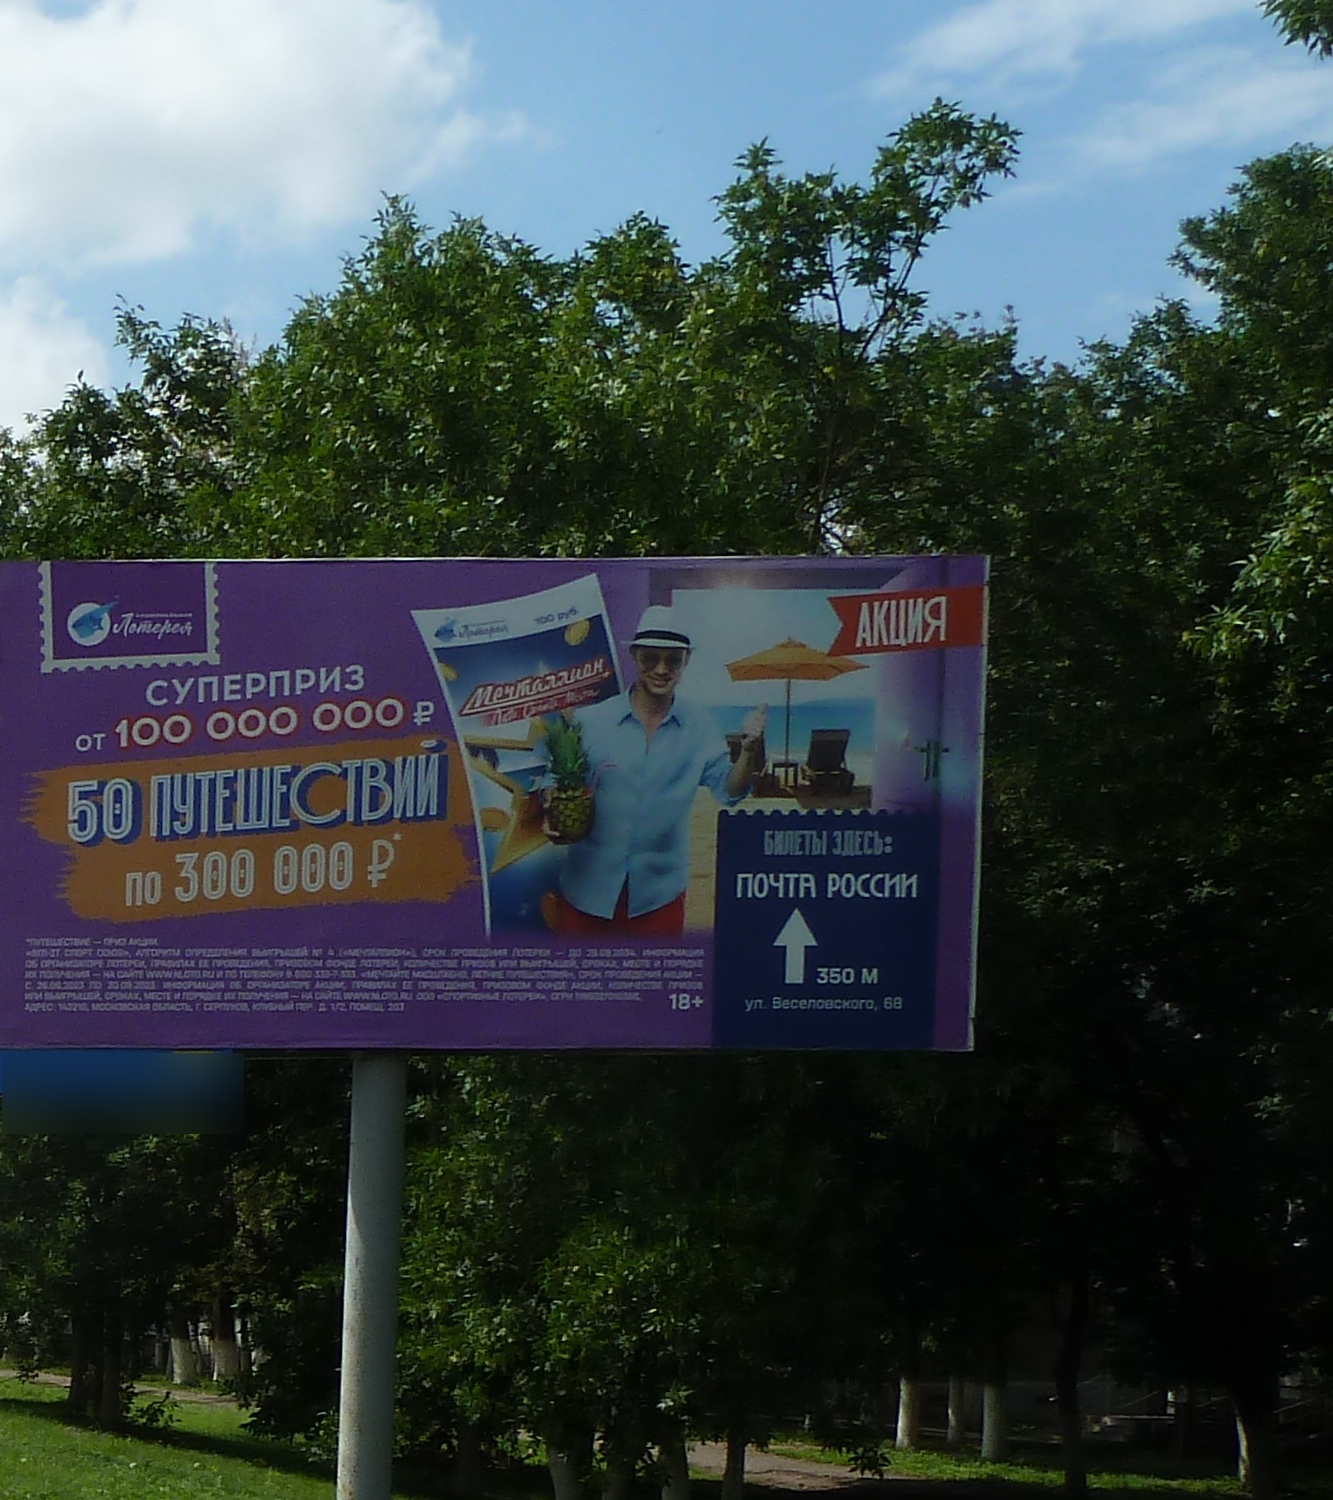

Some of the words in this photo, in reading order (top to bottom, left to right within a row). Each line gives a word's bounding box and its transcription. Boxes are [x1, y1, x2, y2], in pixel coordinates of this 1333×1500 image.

[113, 612, 192, 640] Лотерея
[855, 596, 947, 647] АКЦИЯ
[145, 664, 365, 706] СУПЕРПРИЗ
[465, 658, 605, 710] Мечталлион
[115, 714, 192, 748] 100
[206, 706, 299, 740] 000
[312, 698, 404, 733] 000
[67, 777, 134, 843] 50
[149, 740, 440, 838] ПУТЕШЕСТВИЙ
[763, 830, 828, 856] БИЛЕТЫ
[832, 830, 894, 857] ЗДЕСЬ:
[174, 848, 255, 902] 300
[273, 840, 354, 895] 000
[736, 873, 817, 899] ПОЧТА
[827, 873, 919, 899] РОССИИ
[815, 967, 855, 985] 350
[669, 993, 705, 1011] 18+
[744, 999, 767, 1012] ул.
[772, 996, 878, 1011] Веселовского,
[883, 997, 903, 1010] 68
